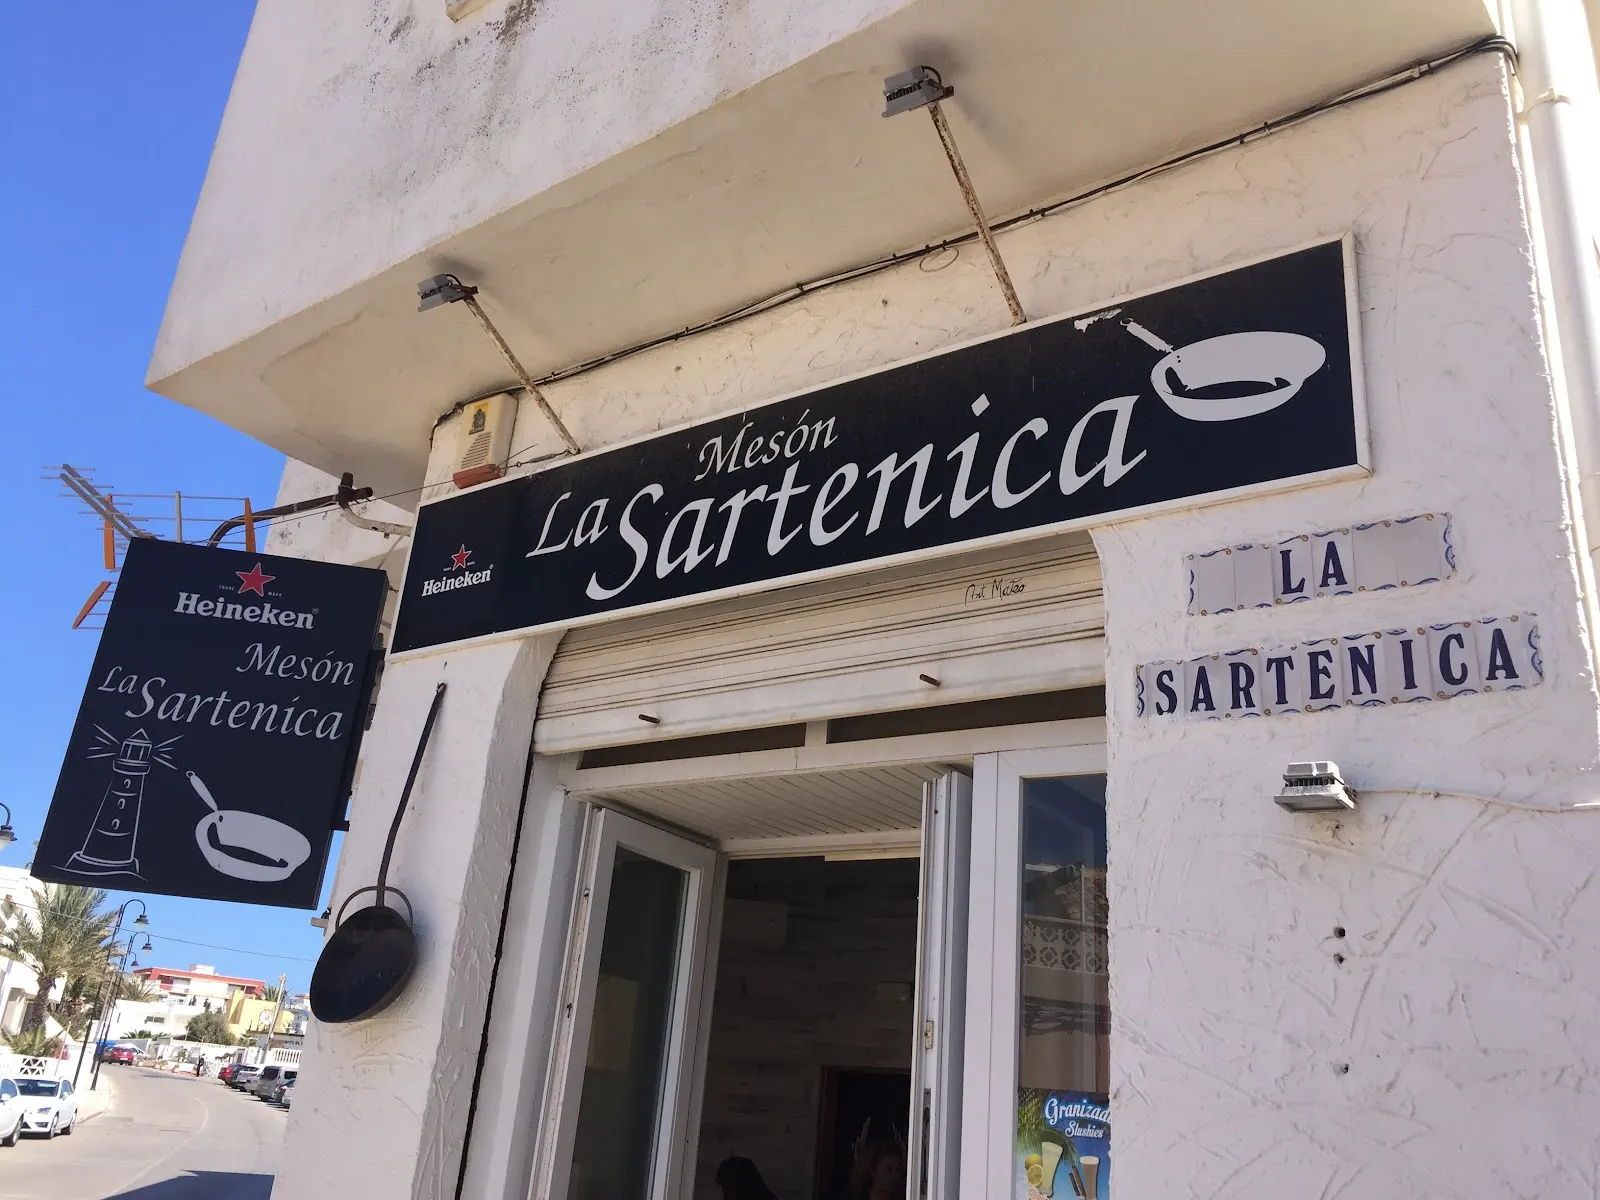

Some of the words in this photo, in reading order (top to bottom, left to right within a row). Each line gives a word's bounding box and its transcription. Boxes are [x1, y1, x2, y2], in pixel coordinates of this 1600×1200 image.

[694, 408, 838, 482] Mesón
[525, 491, 610, 558] La
[585, 393, 1147, 601] Sartenica
[1280, 541, 1348, 595] LA
[97, 666, 139, 694] La
[236, 642, 355, 686] Mesón
[1155, 628, 1520, 716] SARTENICA
[1065, 1120, 1105, 1138] Slushies
